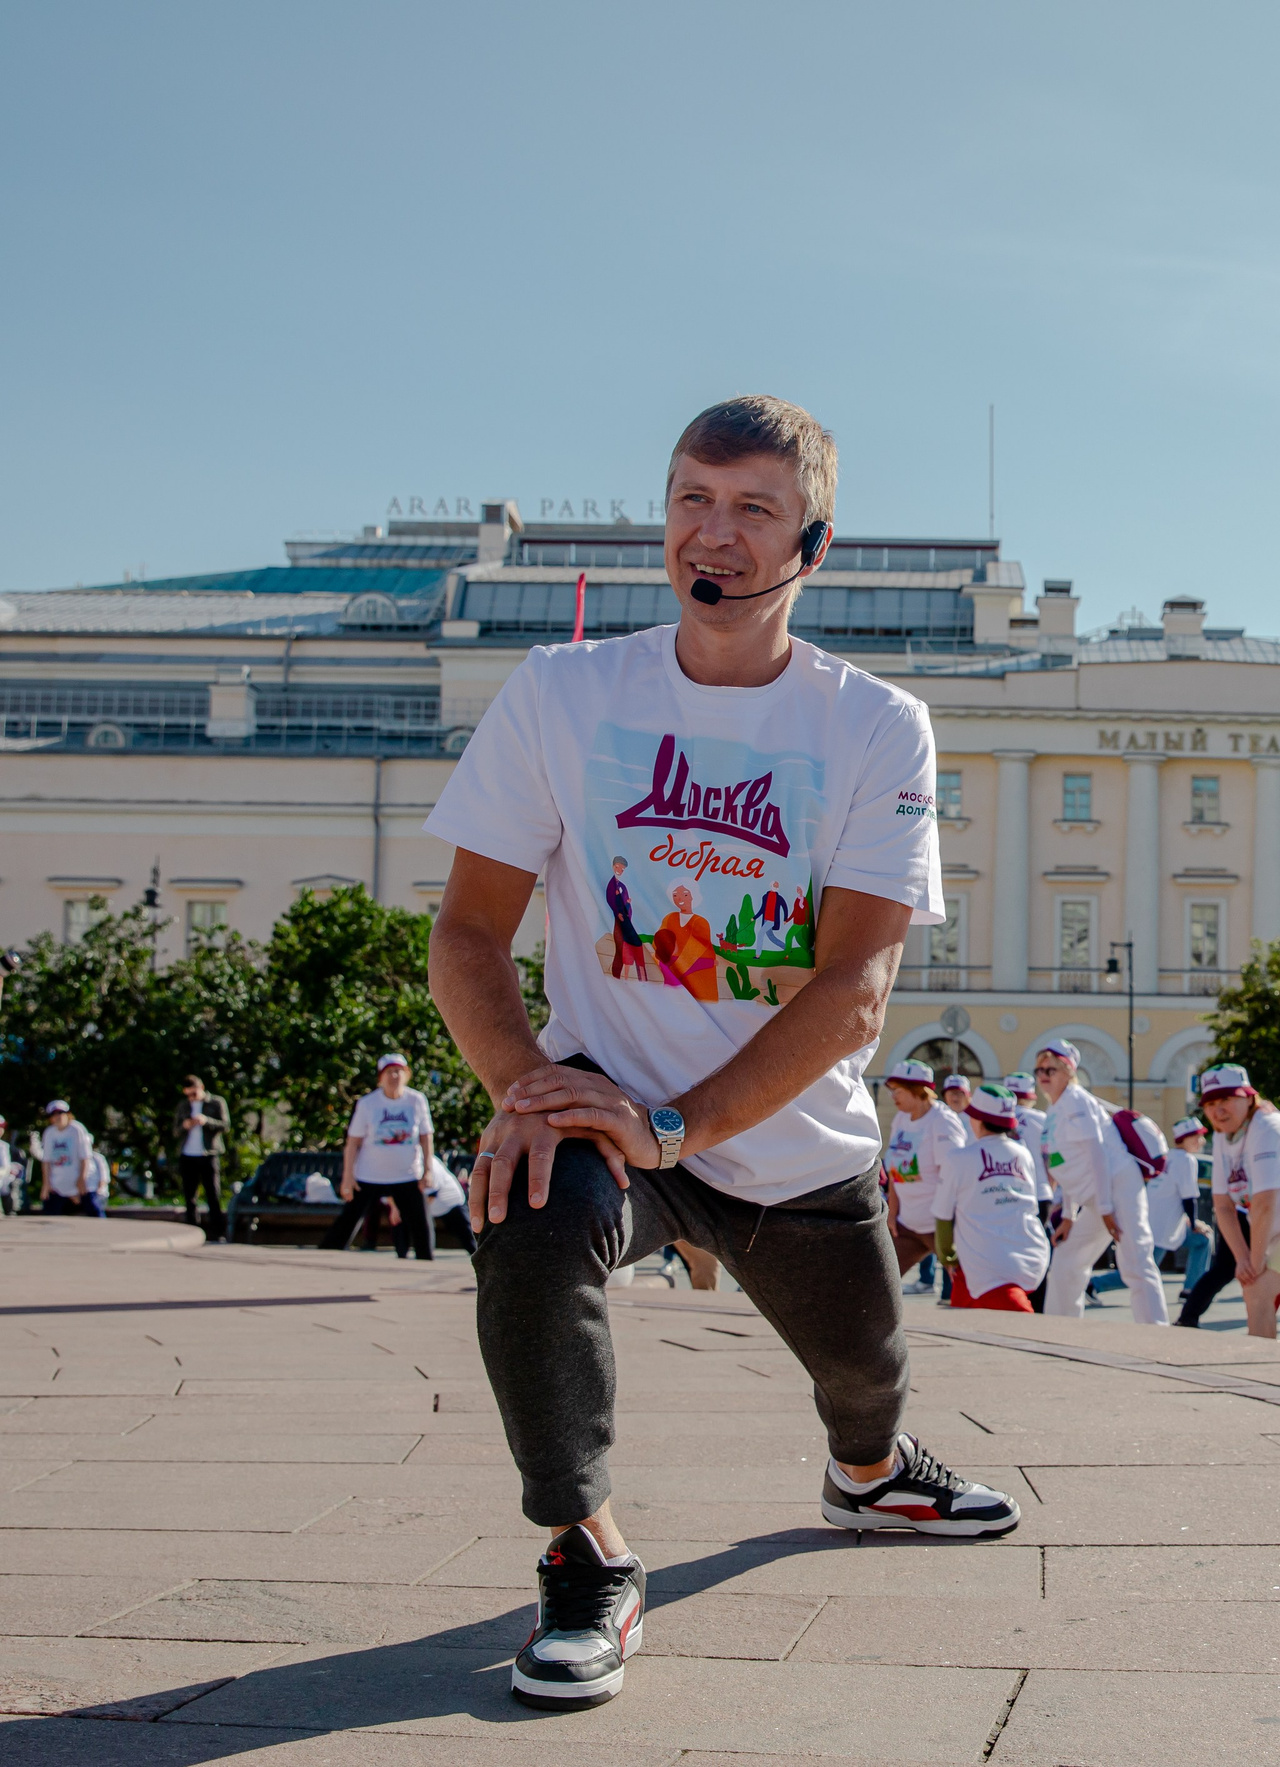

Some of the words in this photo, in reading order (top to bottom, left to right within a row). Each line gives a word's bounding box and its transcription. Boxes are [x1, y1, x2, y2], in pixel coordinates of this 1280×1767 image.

[386, 496, 474, 516] ARAR
[540, 498, 628, 519] PARK
[1098, 728, 1208, 752] МАЛЫЙ
[615, 733, 791, 858] Москва
[649, 833, 765, 881] добрая
